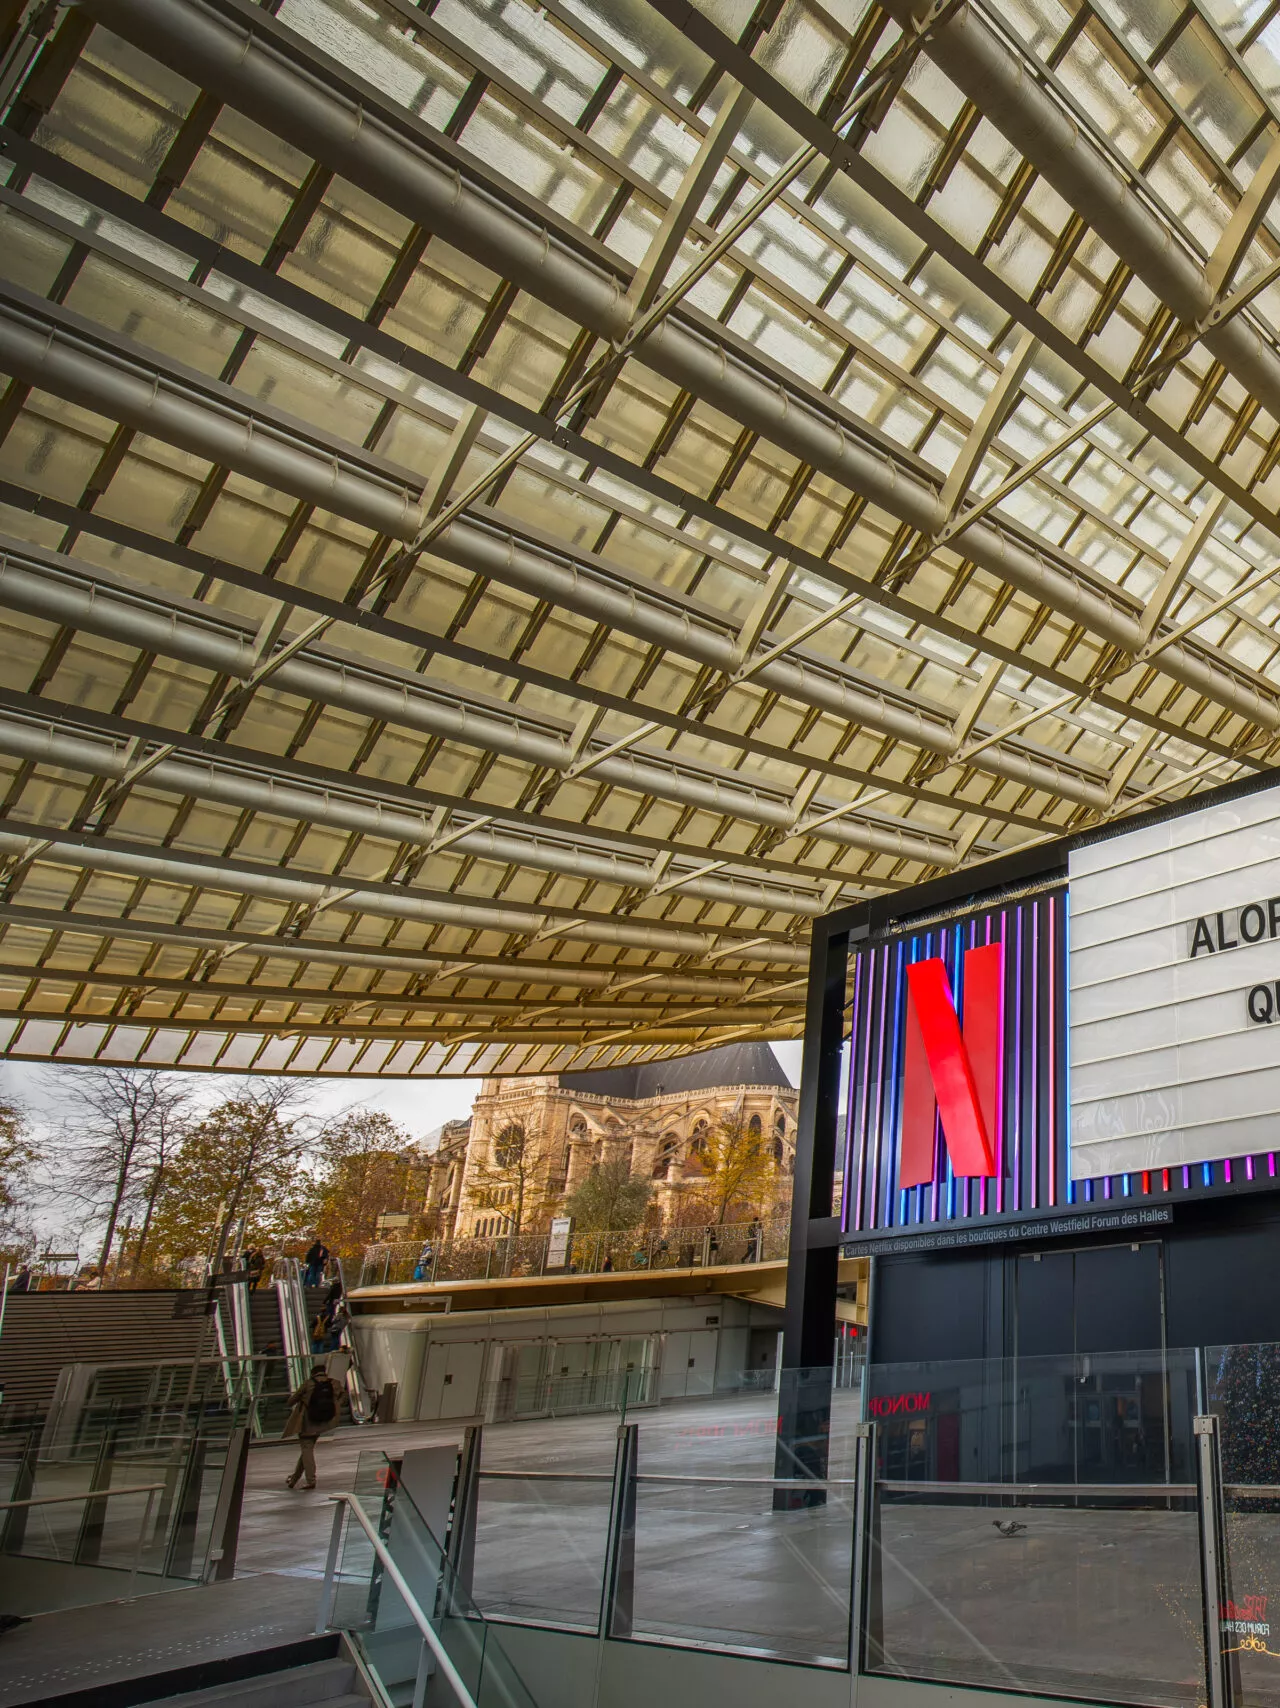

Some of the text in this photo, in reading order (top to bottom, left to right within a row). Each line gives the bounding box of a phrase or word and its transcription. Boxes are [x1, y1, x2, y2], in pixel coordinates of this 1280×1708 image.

[900, 942, 1001, 1189] N
[845, 1209, 1169, 1256] Cartes Netflix disponibles dans les boutiques du Centre Westfield Forum des Halles
